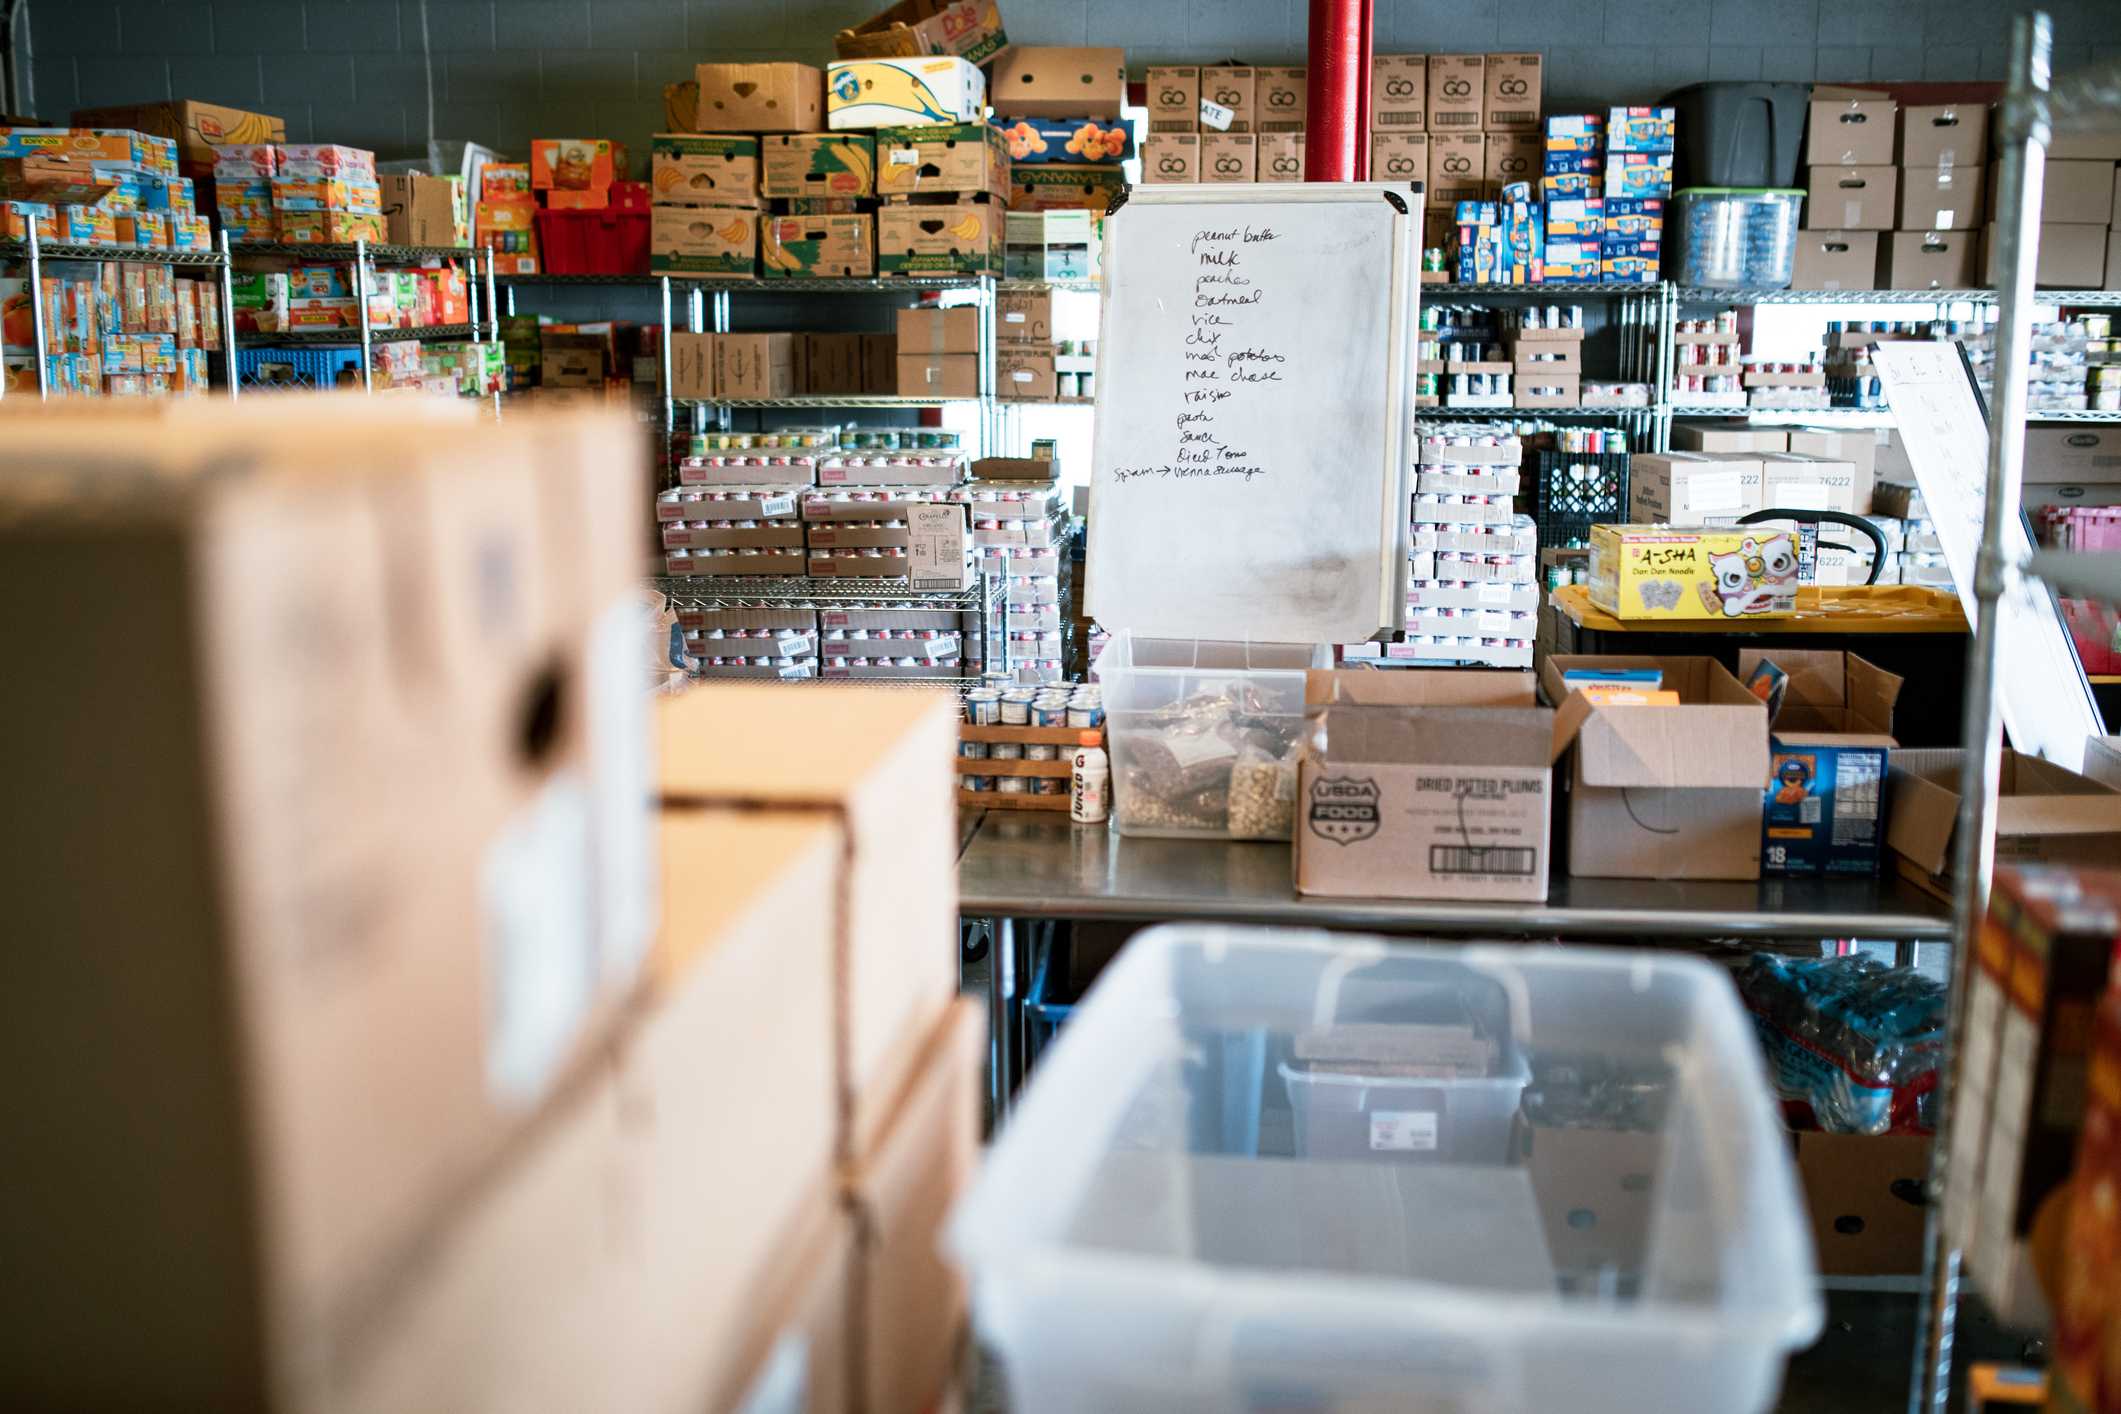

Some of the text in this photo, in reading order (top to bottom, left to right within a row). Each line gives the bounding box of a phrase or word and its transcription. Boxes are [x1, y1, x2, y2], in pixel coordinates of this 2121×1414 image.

[1386, 80, 1414, 96] GO
[1443, 80, 1471, 96] GO
[1500, 79, 1528, 95] GO
[1160, 90, 1186, 105] GO
[1215, 90, 1241, 105] GO
[1269, 91, 1296, 106] GO
[1159, 158, 1186, 173] GO
[1215, 158, 1242, 173] GO
[1272, 158, 1299, 173] GO
[1387, 158, 1415, 173] GO
[1443, 157, 1471, 173] GO
[1500, 157, 1528, 173] GO
[1192, 229, 1240, 254] peanut
[1200, 246, 1241, 267] milk
[1196, 269, 1251, 292] peaches
[1184, 387, 1232, 404] raisins
[1739, 475, 1760, 486] 222
[1640, 547, 1697, 565] A-SHA
[1818, 556, 1845, 567] 6222
[1075, 754, 1085, 769] G
[1316, 784, 1373, 798] USDA
[1415, 777, 1454, 792] DRIED
[1502, 778, 1543, 794] PLUMS
[1315, 806, 1374, 820] FOOD
[1766, 846, 1786, 863] 18
